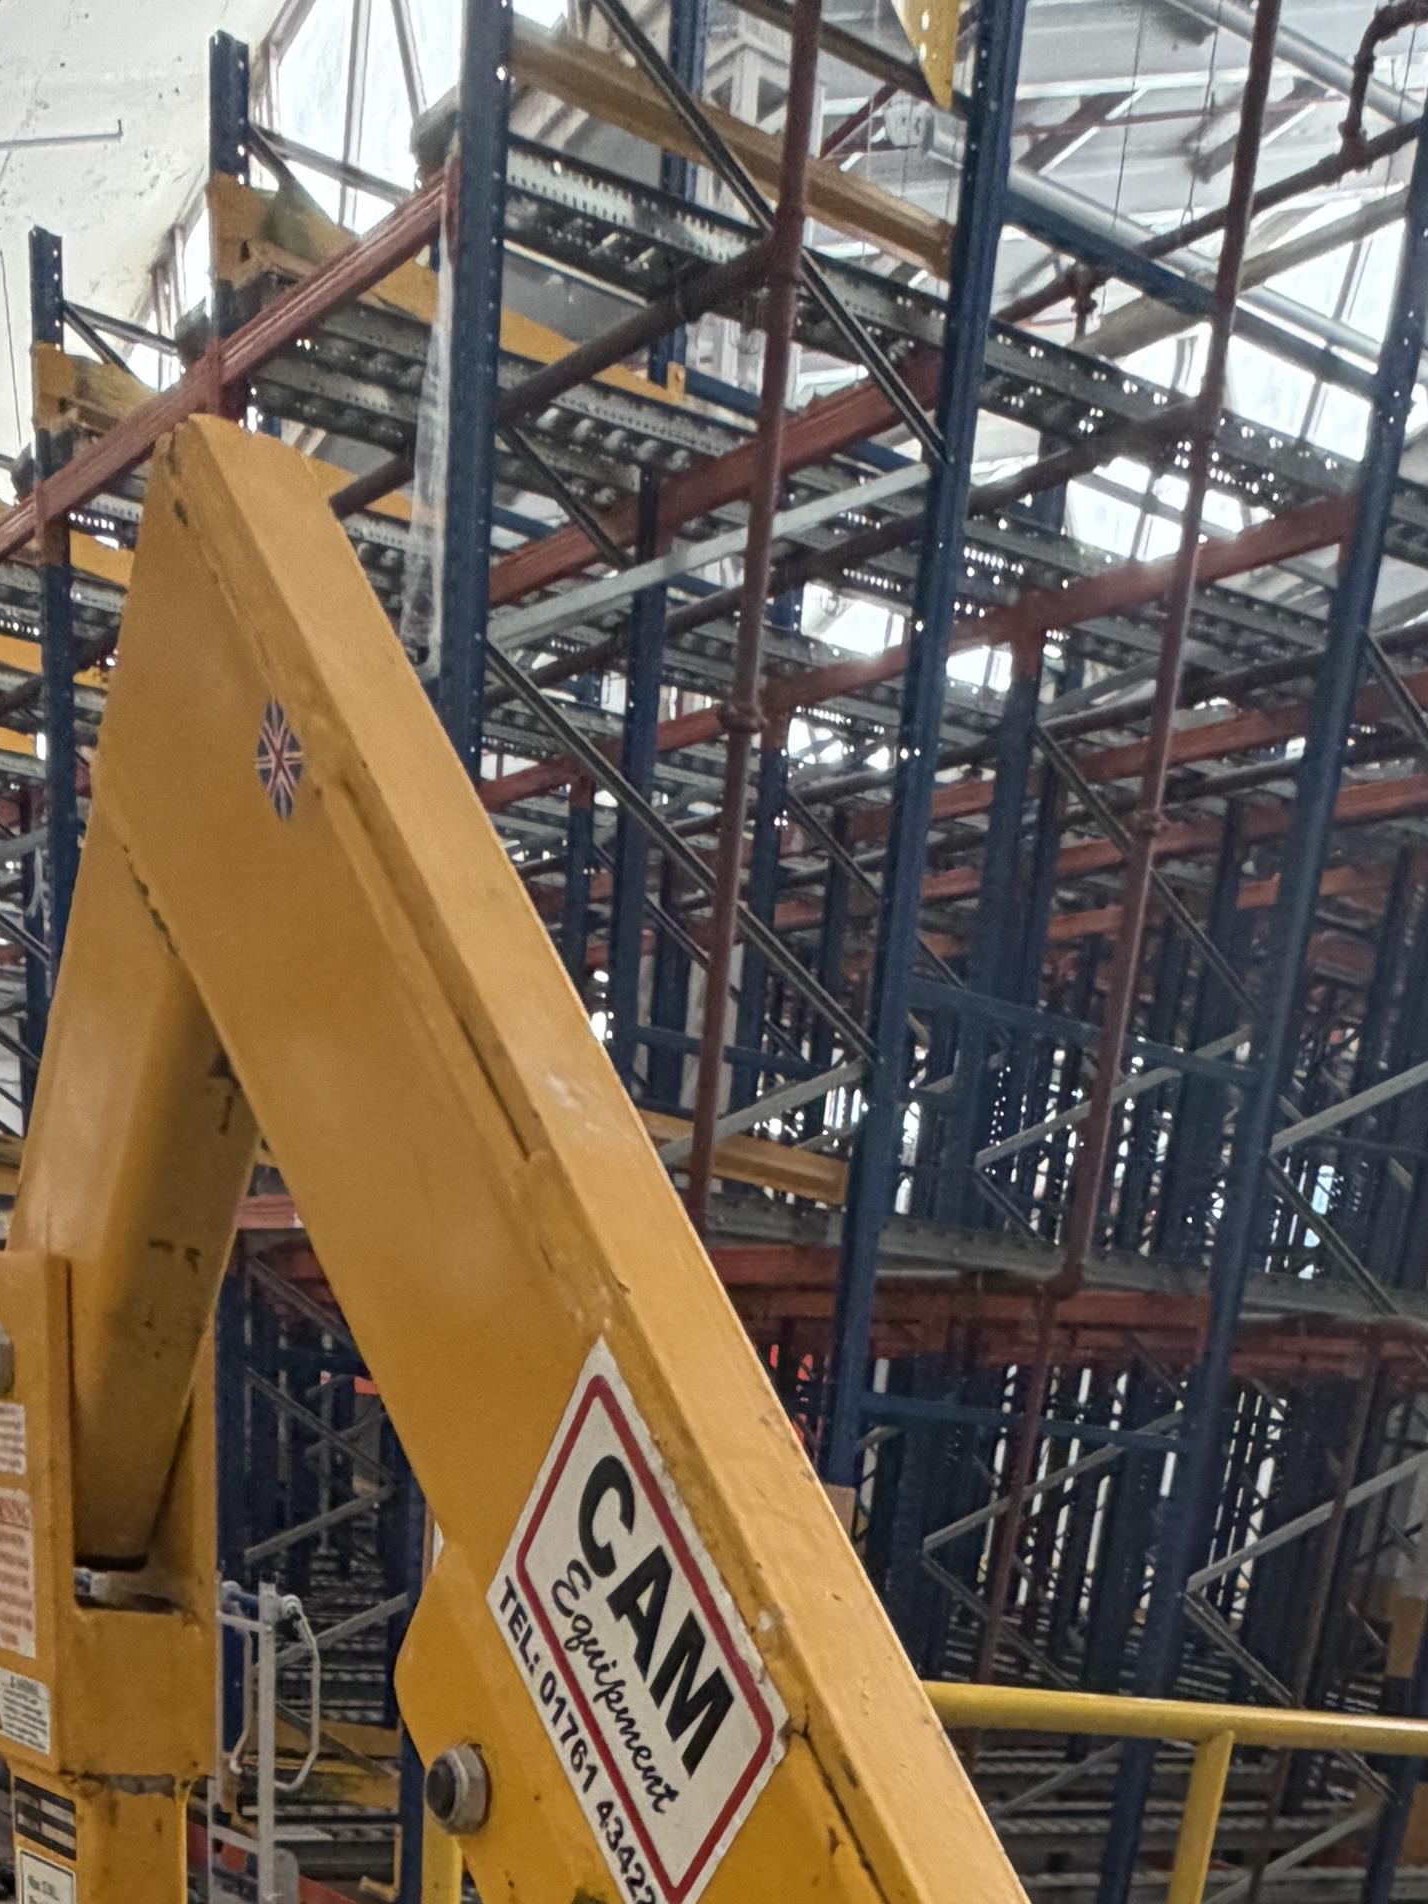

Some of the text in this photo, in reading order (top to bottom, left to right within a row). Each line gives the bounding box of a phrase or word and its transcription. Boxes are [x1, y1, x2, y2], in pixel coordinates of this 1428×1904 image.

[497, 1576, 539, 1673] TEL:
[539, 1670, 597, 1792] 01761
[551, 1559, 679, 1815] Equipment
[579, 1455, 734, 1777] CAM
